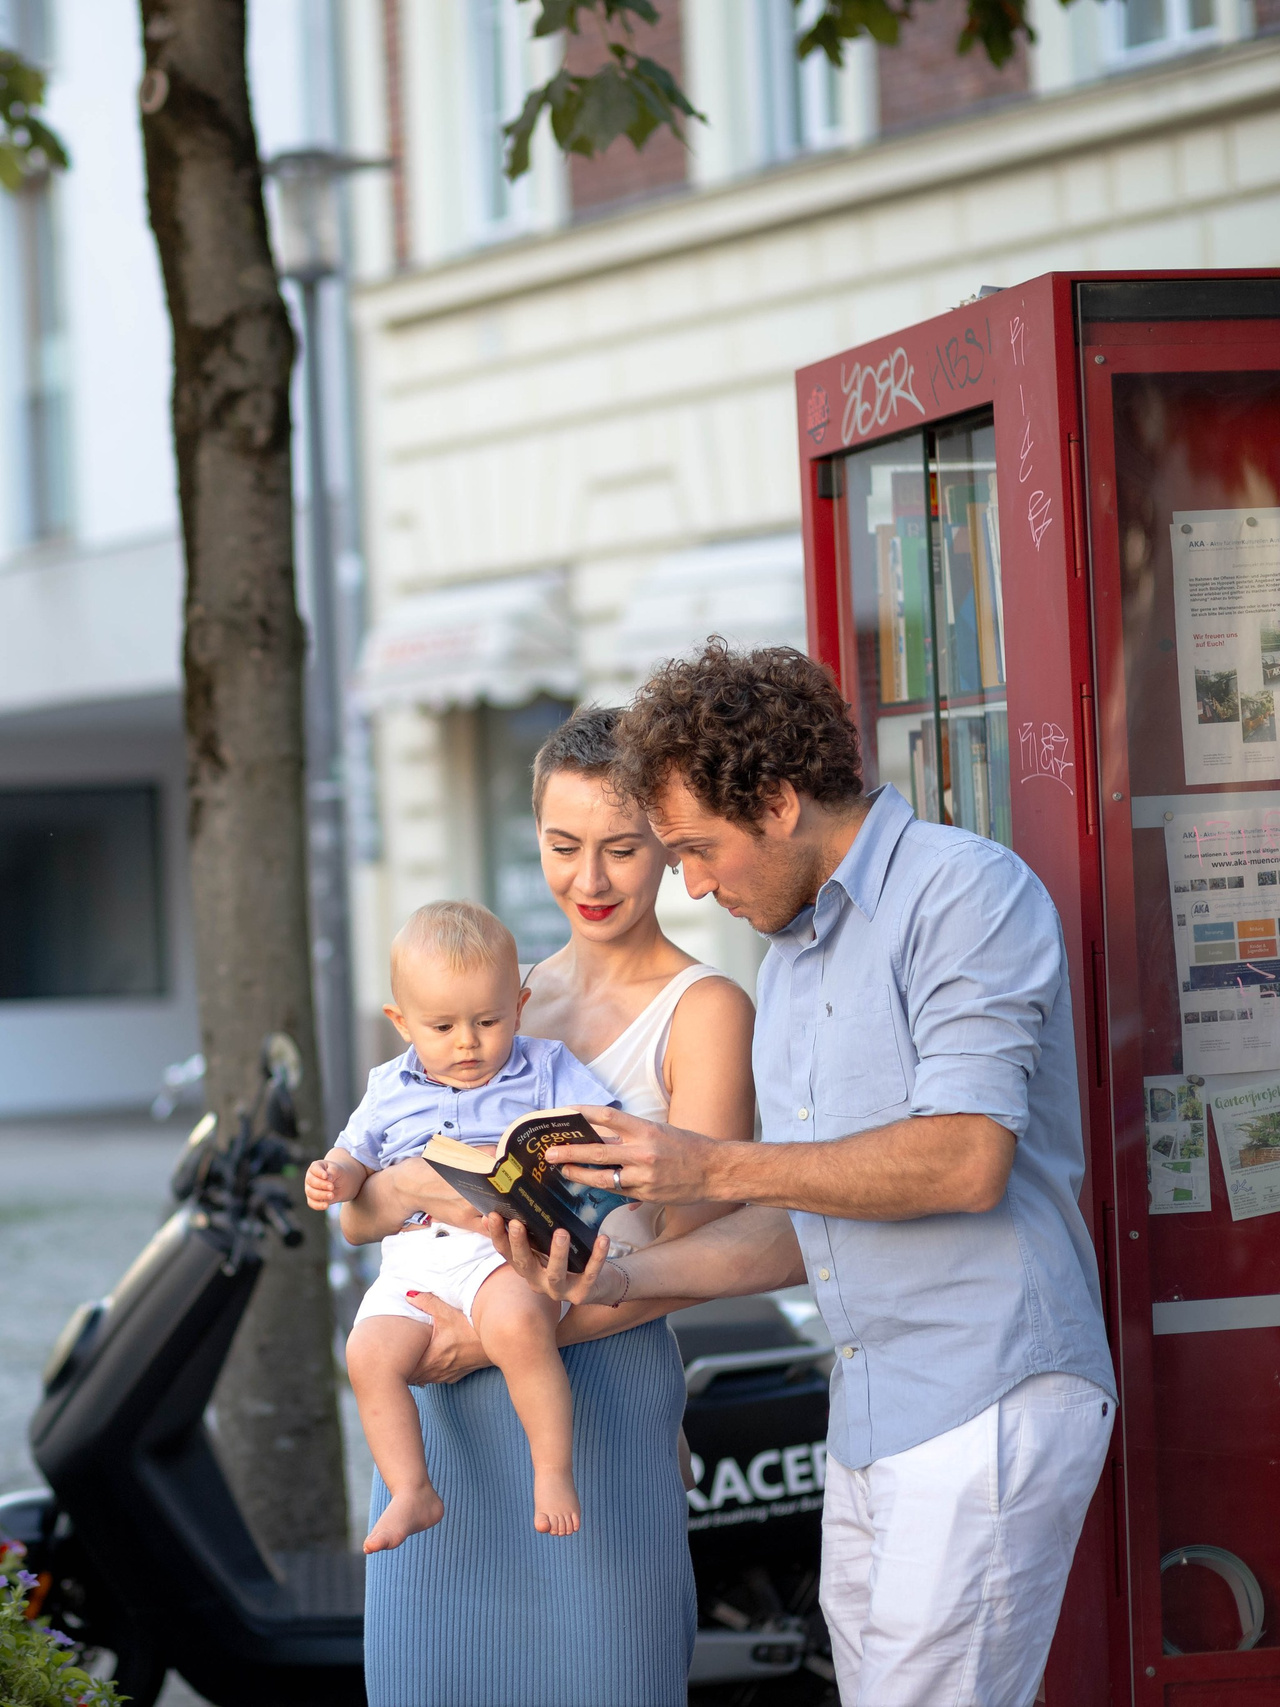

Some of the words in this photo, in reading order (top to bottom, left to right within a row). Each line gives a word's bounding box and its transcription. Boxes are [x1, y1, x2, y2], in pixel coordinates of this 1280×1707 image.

[1189, 540, 1204, 548] AKA
[1194, 904, 1209, 913] AKA
[517, 1124, 549, 1145] Stephanie
[526, 1130, 585, 1154] Gegen
